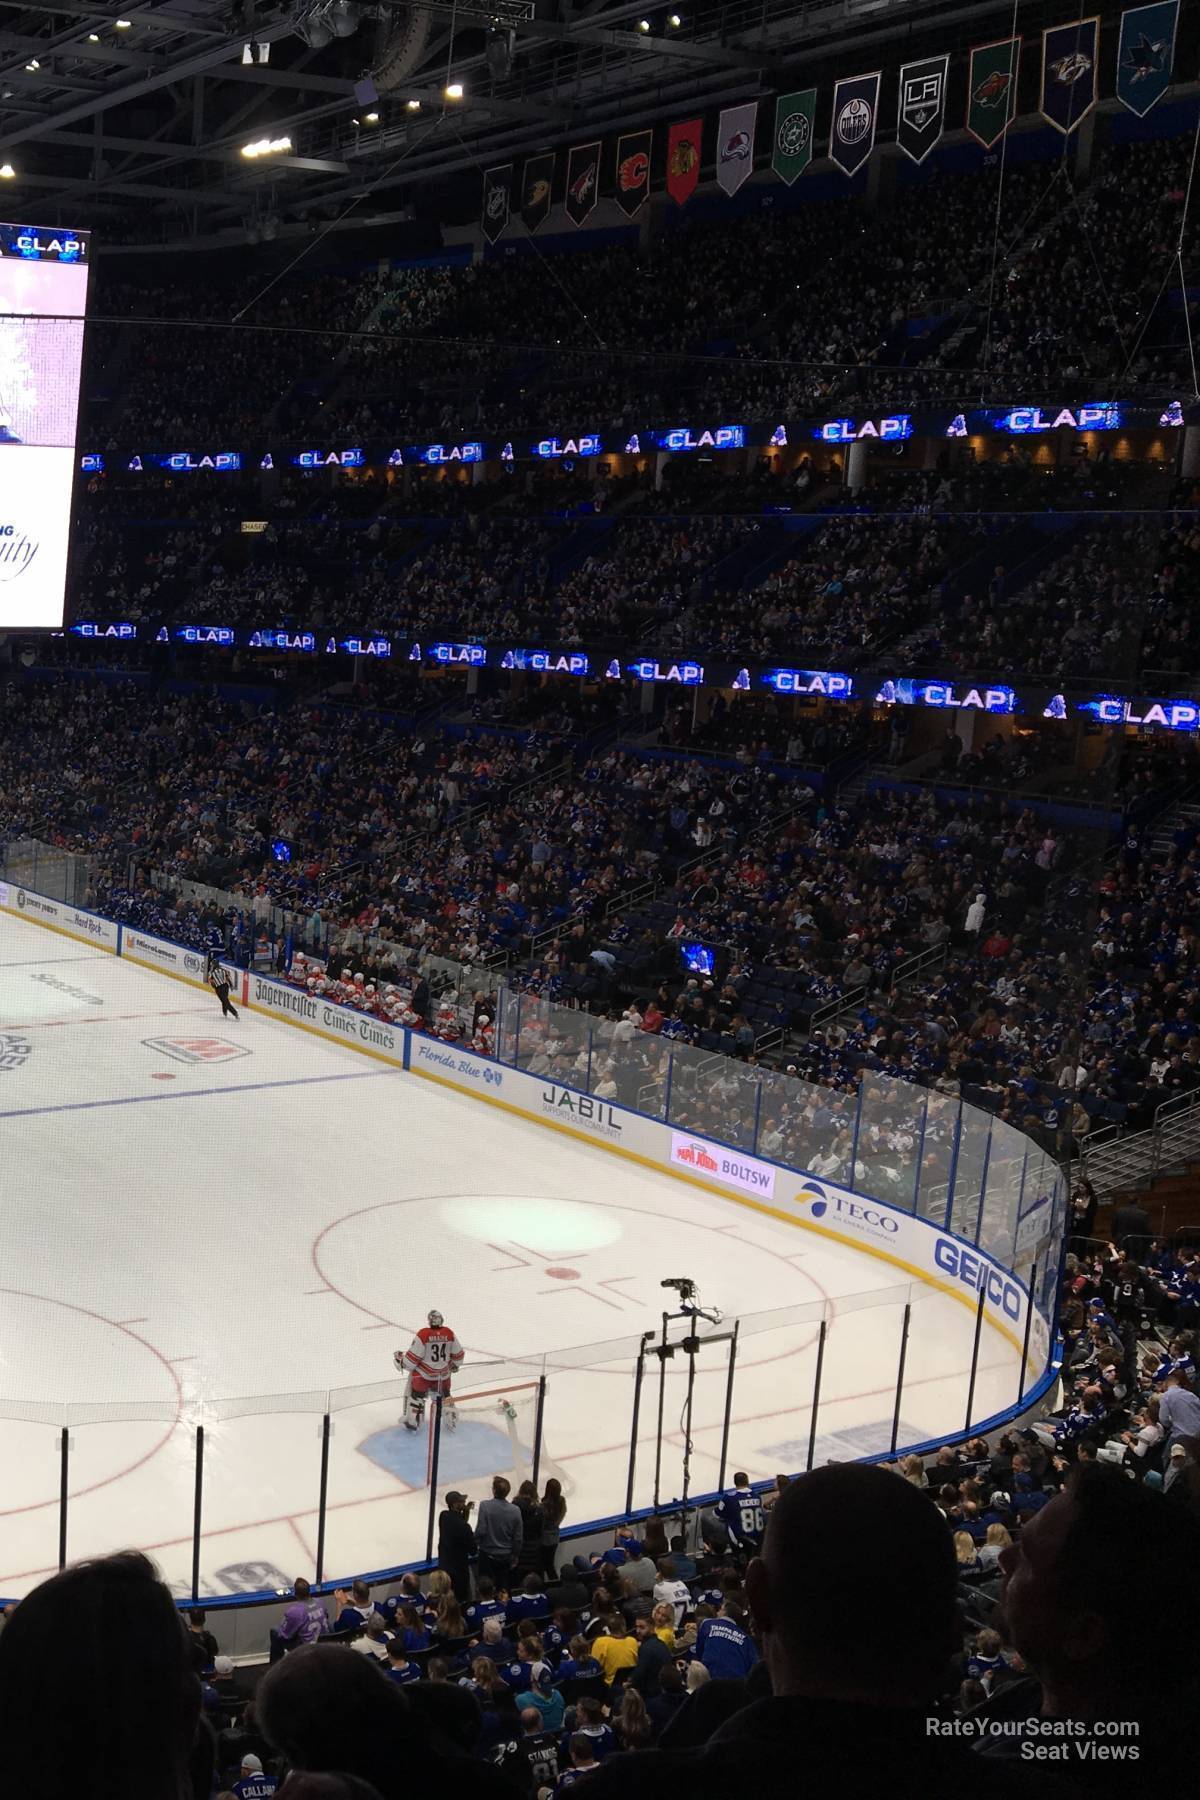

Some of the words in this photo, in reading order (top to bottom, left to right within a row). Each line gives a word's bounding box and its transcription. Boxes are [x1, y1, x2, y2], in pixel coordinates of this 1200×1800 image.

[906, 80, 938, 103] LA
[17, 235, 86, 255] CLAP!
[1010, 408, 1113, 430] CLAP!
[669, 431, 741, 448] CLAP!
[823, 419, 907, 440] CLAP!
[428, 445, 480, 461] CLAP!
[538, 438, 599, 455] CLAP!
[170, 453, 239, 469] CLAP!
[299, 452, 360, 466] CLAP!
[81, 624, 137, 638] CLAP!
[185, 628, 235, 643] CLAP!
[276, 634, 315, 649] CLAP!
[348, 640, 391, 656] CLAP!
[438, 646, 487, 664] CLAP!
[532, 654, 588, 674] CLAP!
[639, 663, 704, 683] CLAP!
[776, 673, 853, 696] CLAP!
[924, 686, 1014, 712] CLAP!
[323, 1006, 356, 1034] Times
[360, 1019, 396, 1050] Times
[418, 1046, 455, 1069] Florida
[458, 1060, 481, 1078] Blue
[543, 1085, 622, 1130] JABIL
[722, 1160, 770, 1189] BOLTSW
[832, 1196, 899, 1233] TECO
[935, 1237, 1022, 1322] GEICO
[431, 1343, 446, 1362] 34
[740, 1508, 764, 1534] 86
[708, 1630, 744, 1646] LIGHTNING
[711, 1625, 733, 1637] TAMPA
[733, 1631, 746, 1640] BAY
